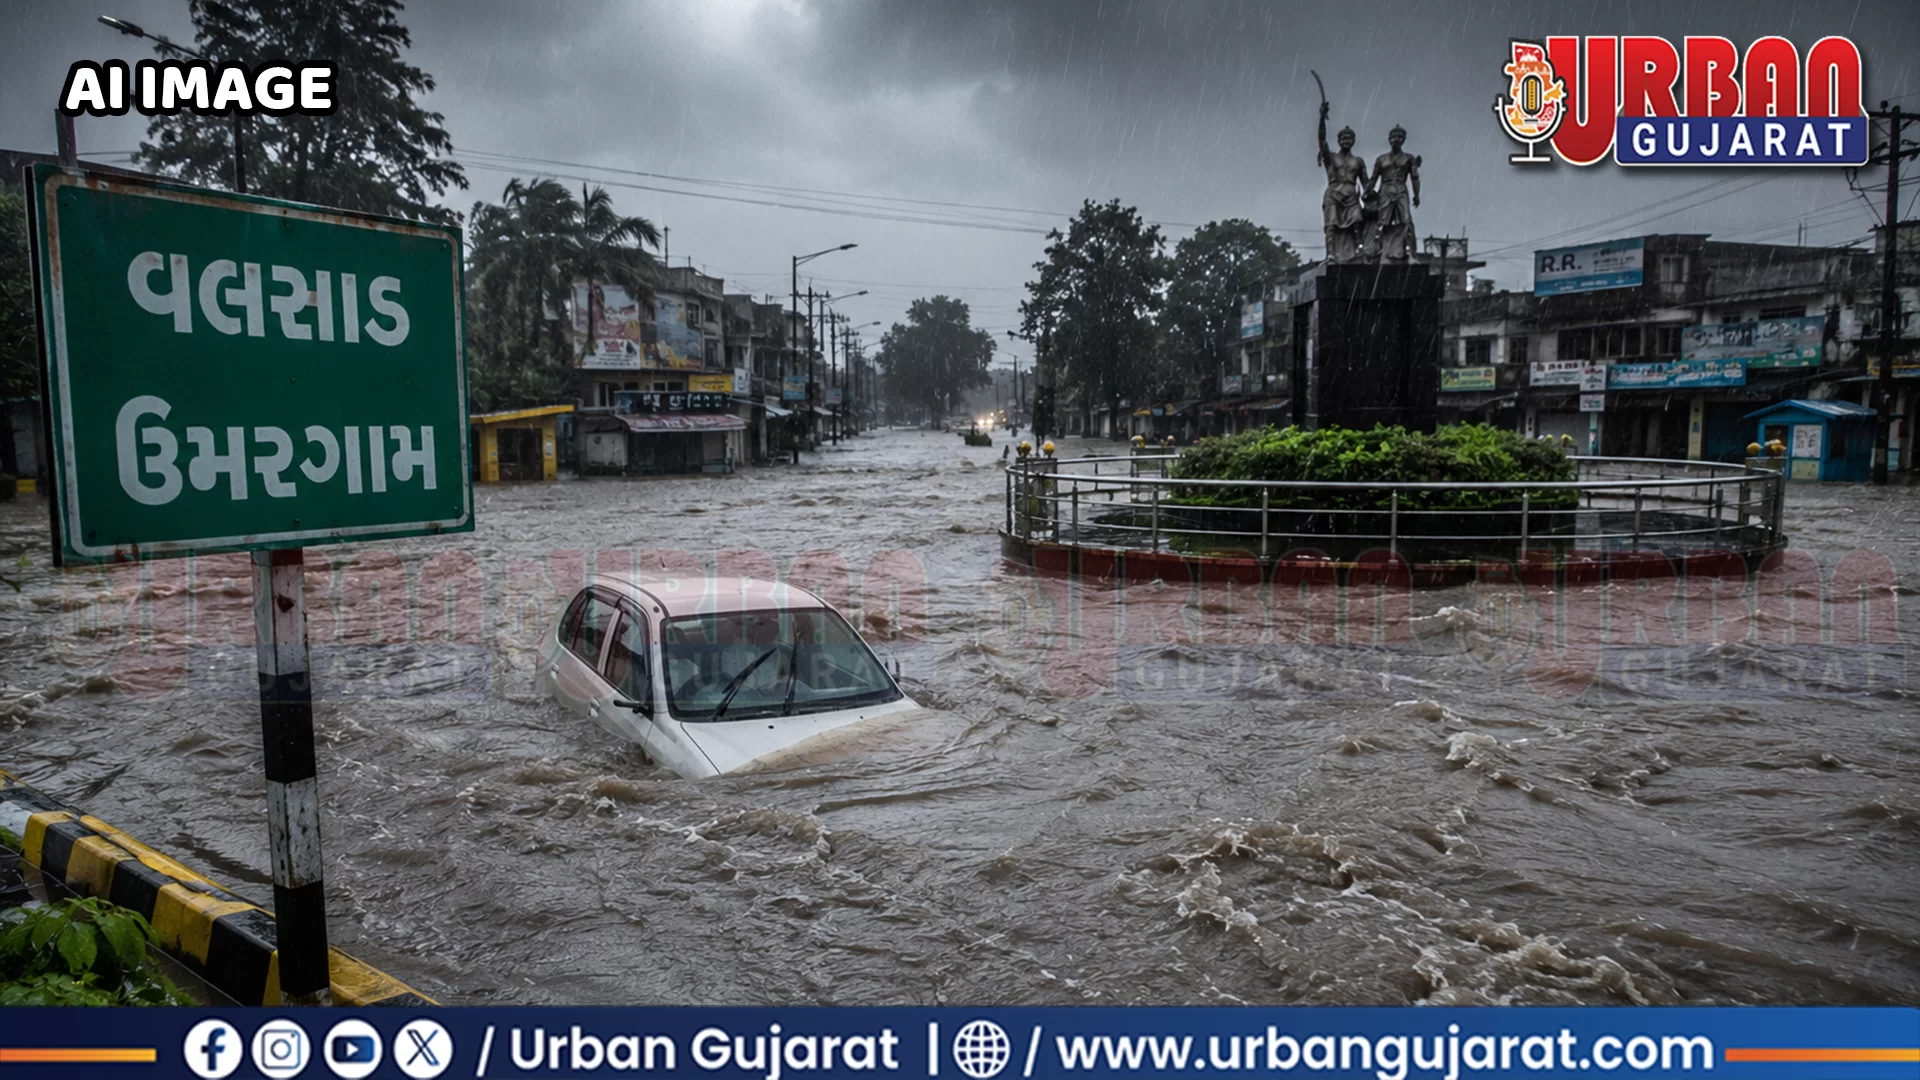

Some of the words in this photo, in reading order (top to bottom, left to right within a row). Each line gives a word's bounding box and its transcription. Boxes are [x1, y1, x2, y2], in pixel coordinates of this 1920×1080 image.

[128, 251, 410, 347] વલસાડ
[1541, 253, 1582, 274] R.R.
[116, 395, 437, 506] ઉમરગામ
